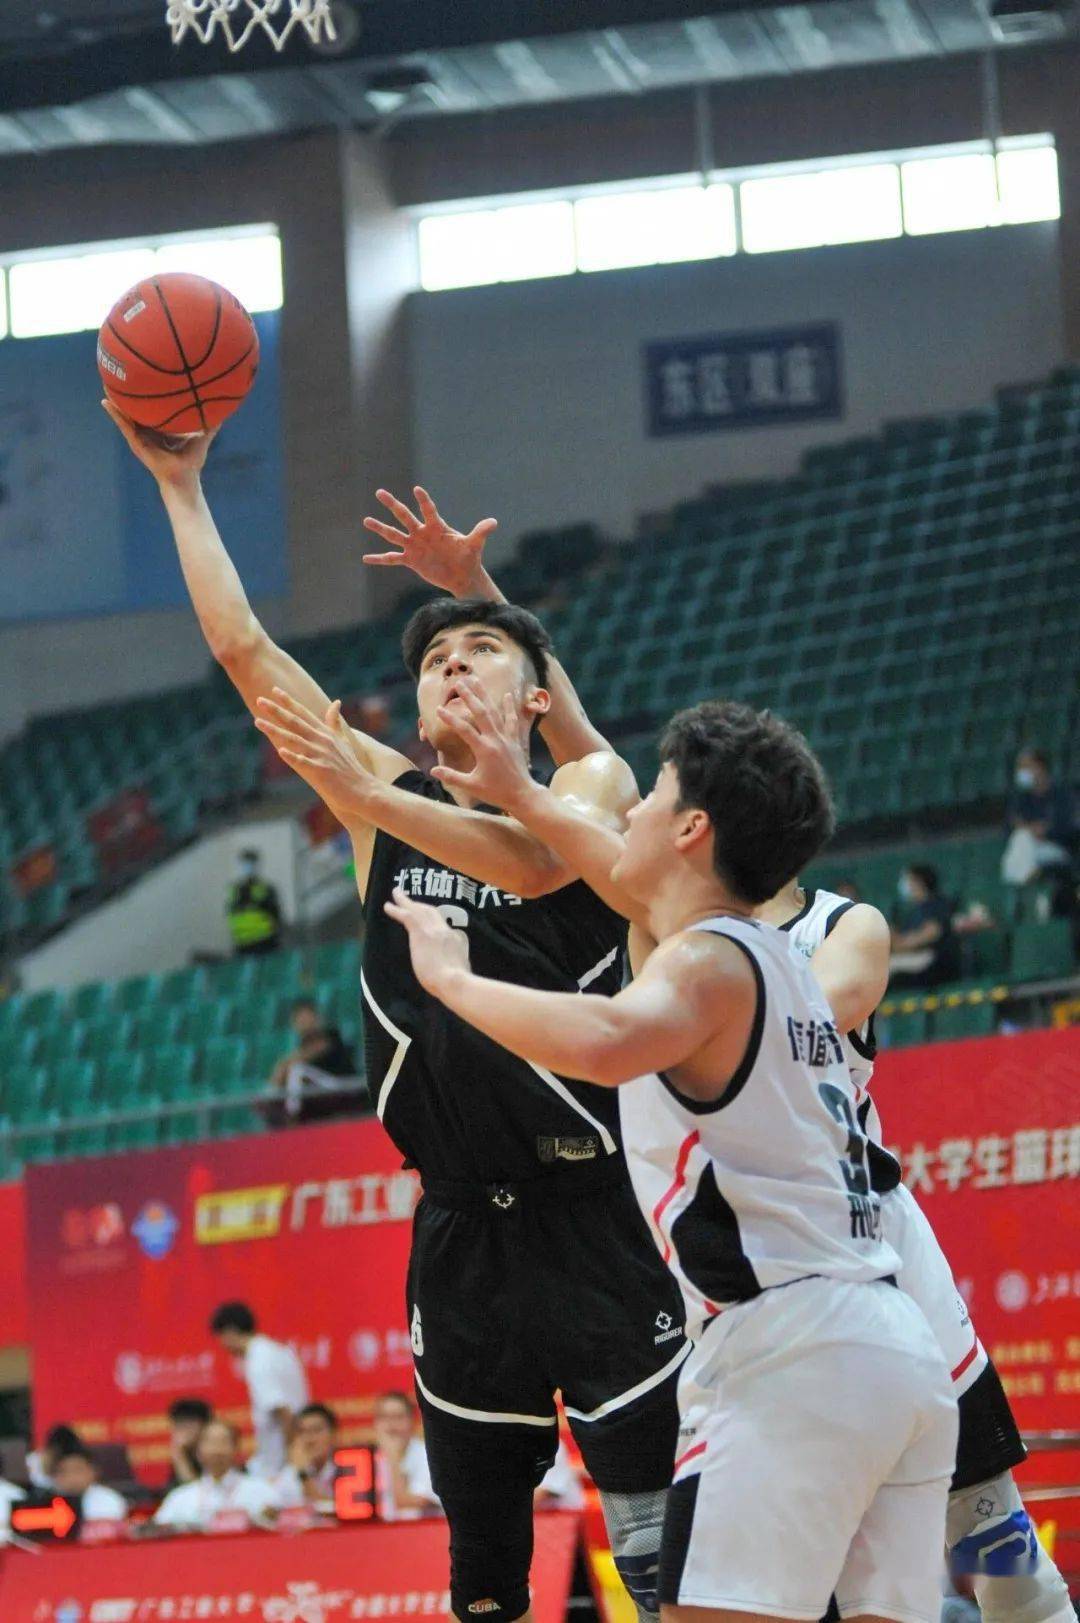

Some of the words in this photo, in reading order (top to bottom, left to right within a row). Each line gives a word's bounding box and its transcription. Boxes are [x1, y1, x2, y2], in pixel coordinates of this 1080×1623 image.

[900, 1125, 1080, 1194] 大学生篮球
[654, 1326, 683, 1345] RIGORER
[334, 1448, 374, 1520] 2
[467, 1601, 502, 1614] CUBA
